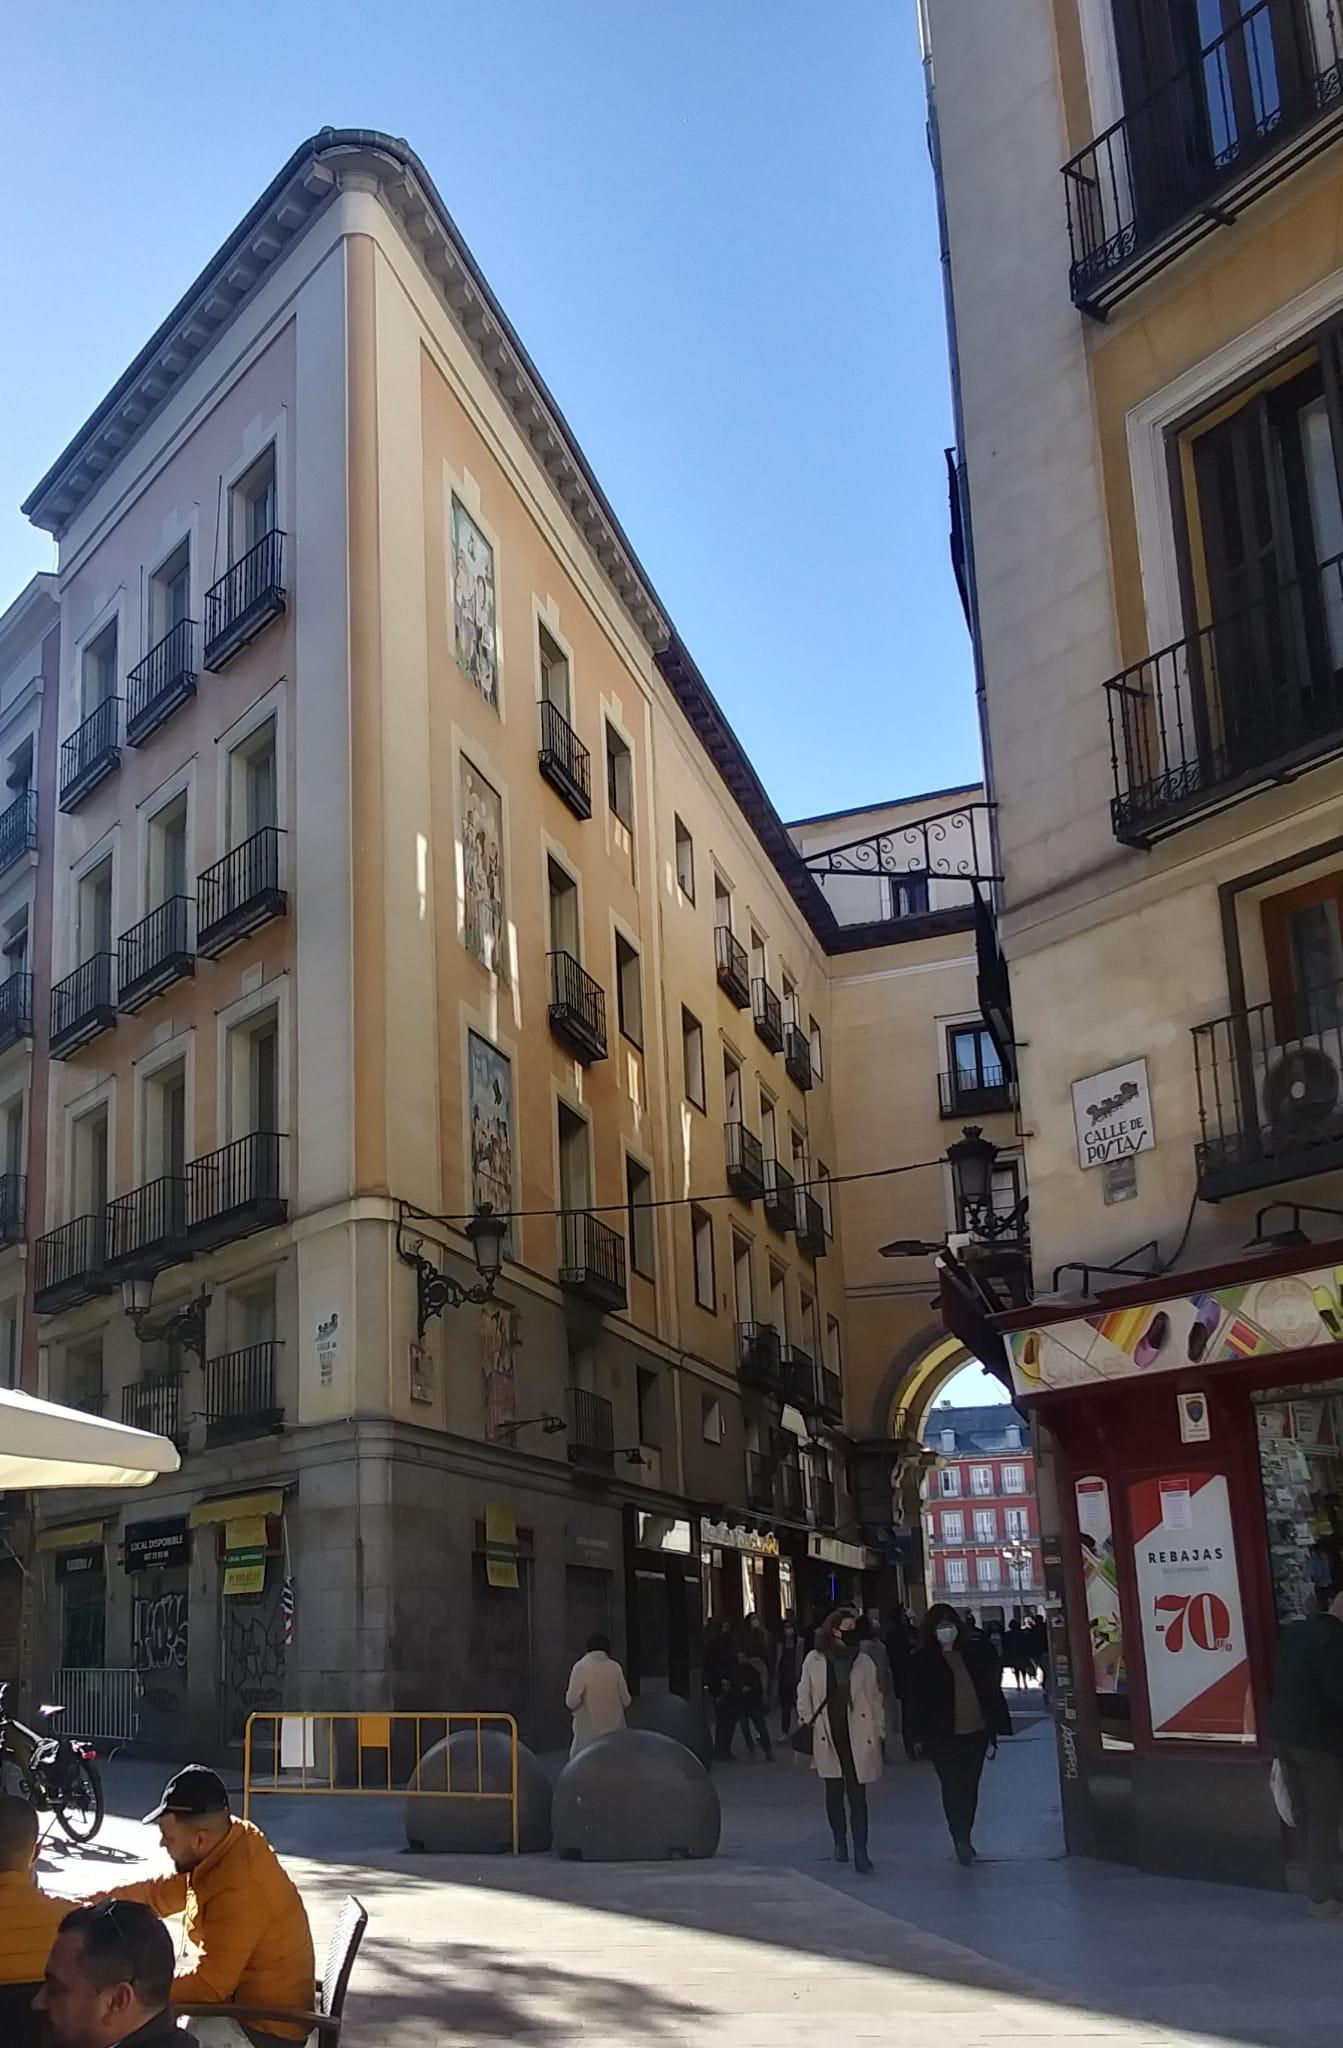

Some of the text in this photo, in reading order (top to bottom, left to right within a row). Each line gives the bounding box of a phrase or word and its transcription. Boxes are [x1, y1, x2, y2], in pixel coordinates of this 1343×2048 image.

[1083, 1116, 1144, 1146] CALLE DE
[1086, 1129, 1148, 1164] POSTAS
[130, 1534, 184, 1552] LOCAL DISPONIBLE
[1148, 1547, 1225, 1564] REBAJAS
